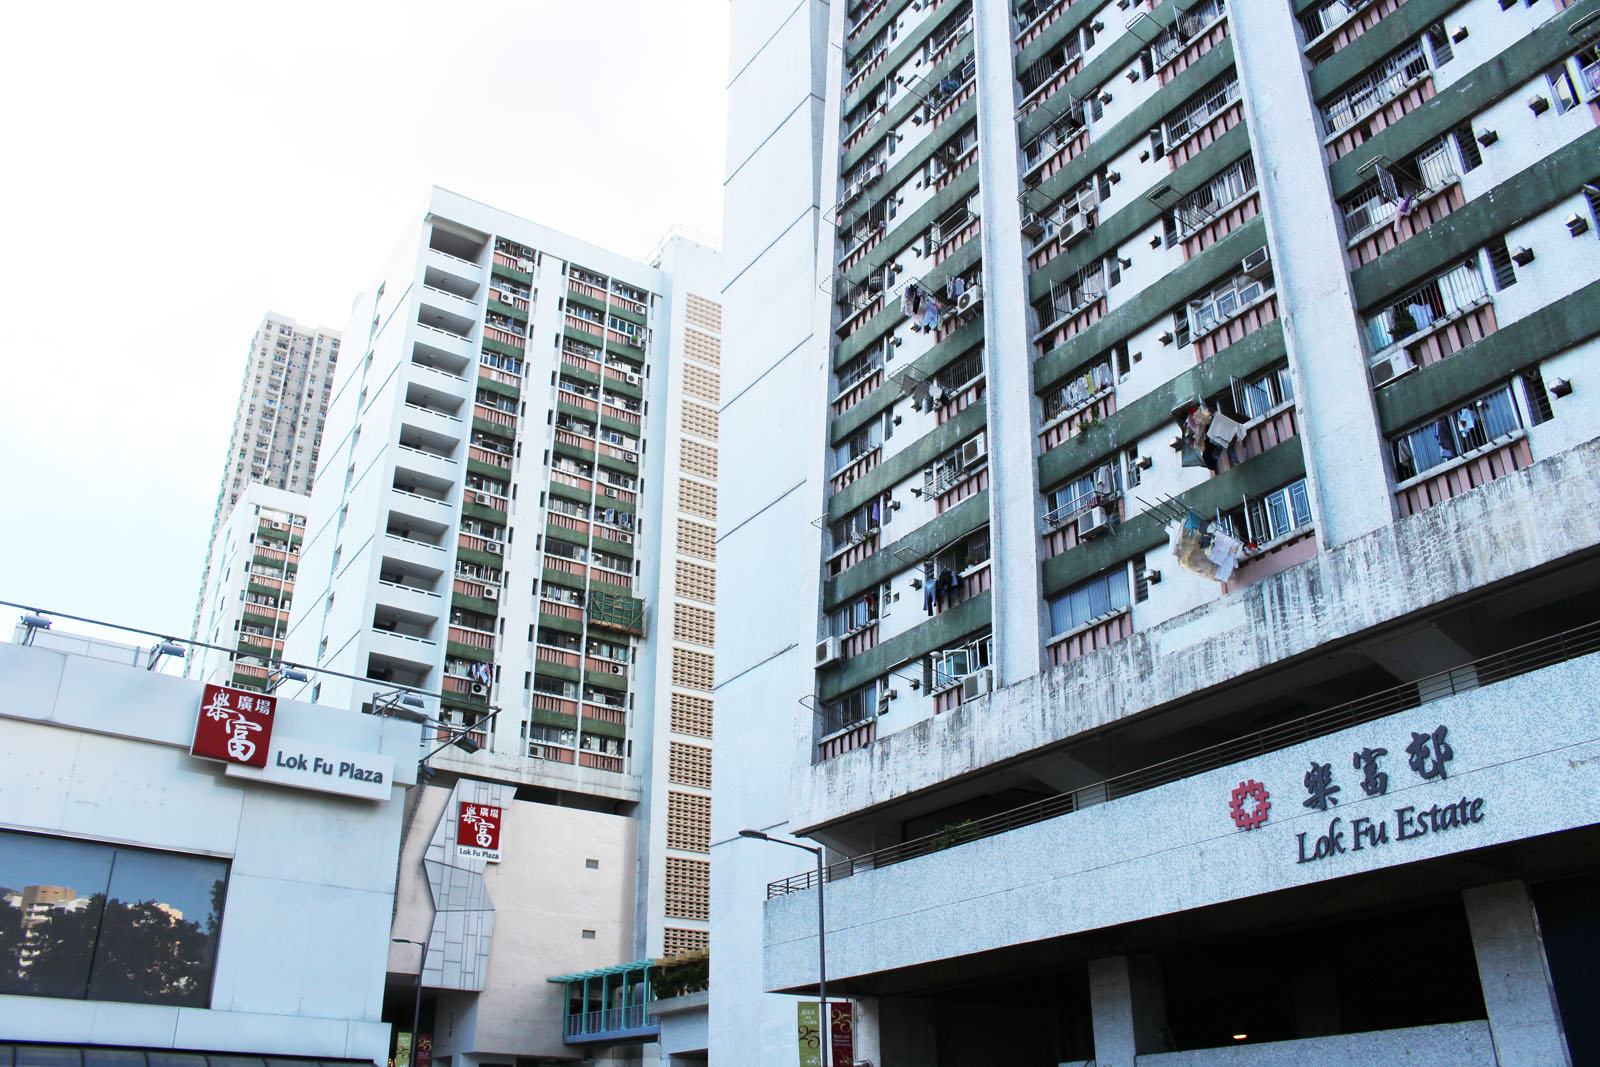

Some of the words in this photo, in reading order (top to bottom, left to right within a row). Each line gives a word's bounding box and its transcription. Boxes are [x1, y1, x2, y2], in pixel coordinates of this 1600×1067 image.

[237, 695, 272, 715] 廣場
[276, 751, 308, 771] Lok
[313, 757, 333, 775] Fu
[339, 762, 384, 784] Plaza
[1302, 724, 1454, 812] 樂富邨
[1295, 816, 1346, 864] Lok
[1350, 816, 1389, 852] Fu
[1394, 796, 1485, 842] Estate
[460, 847, 472, 856] Lok
[472, 849, 481, 857] Fu
[482, 850, 499, 859] Plaza
[831, 1009, 852, 1033] 25
[798, 1025, 820, 1049] 25
